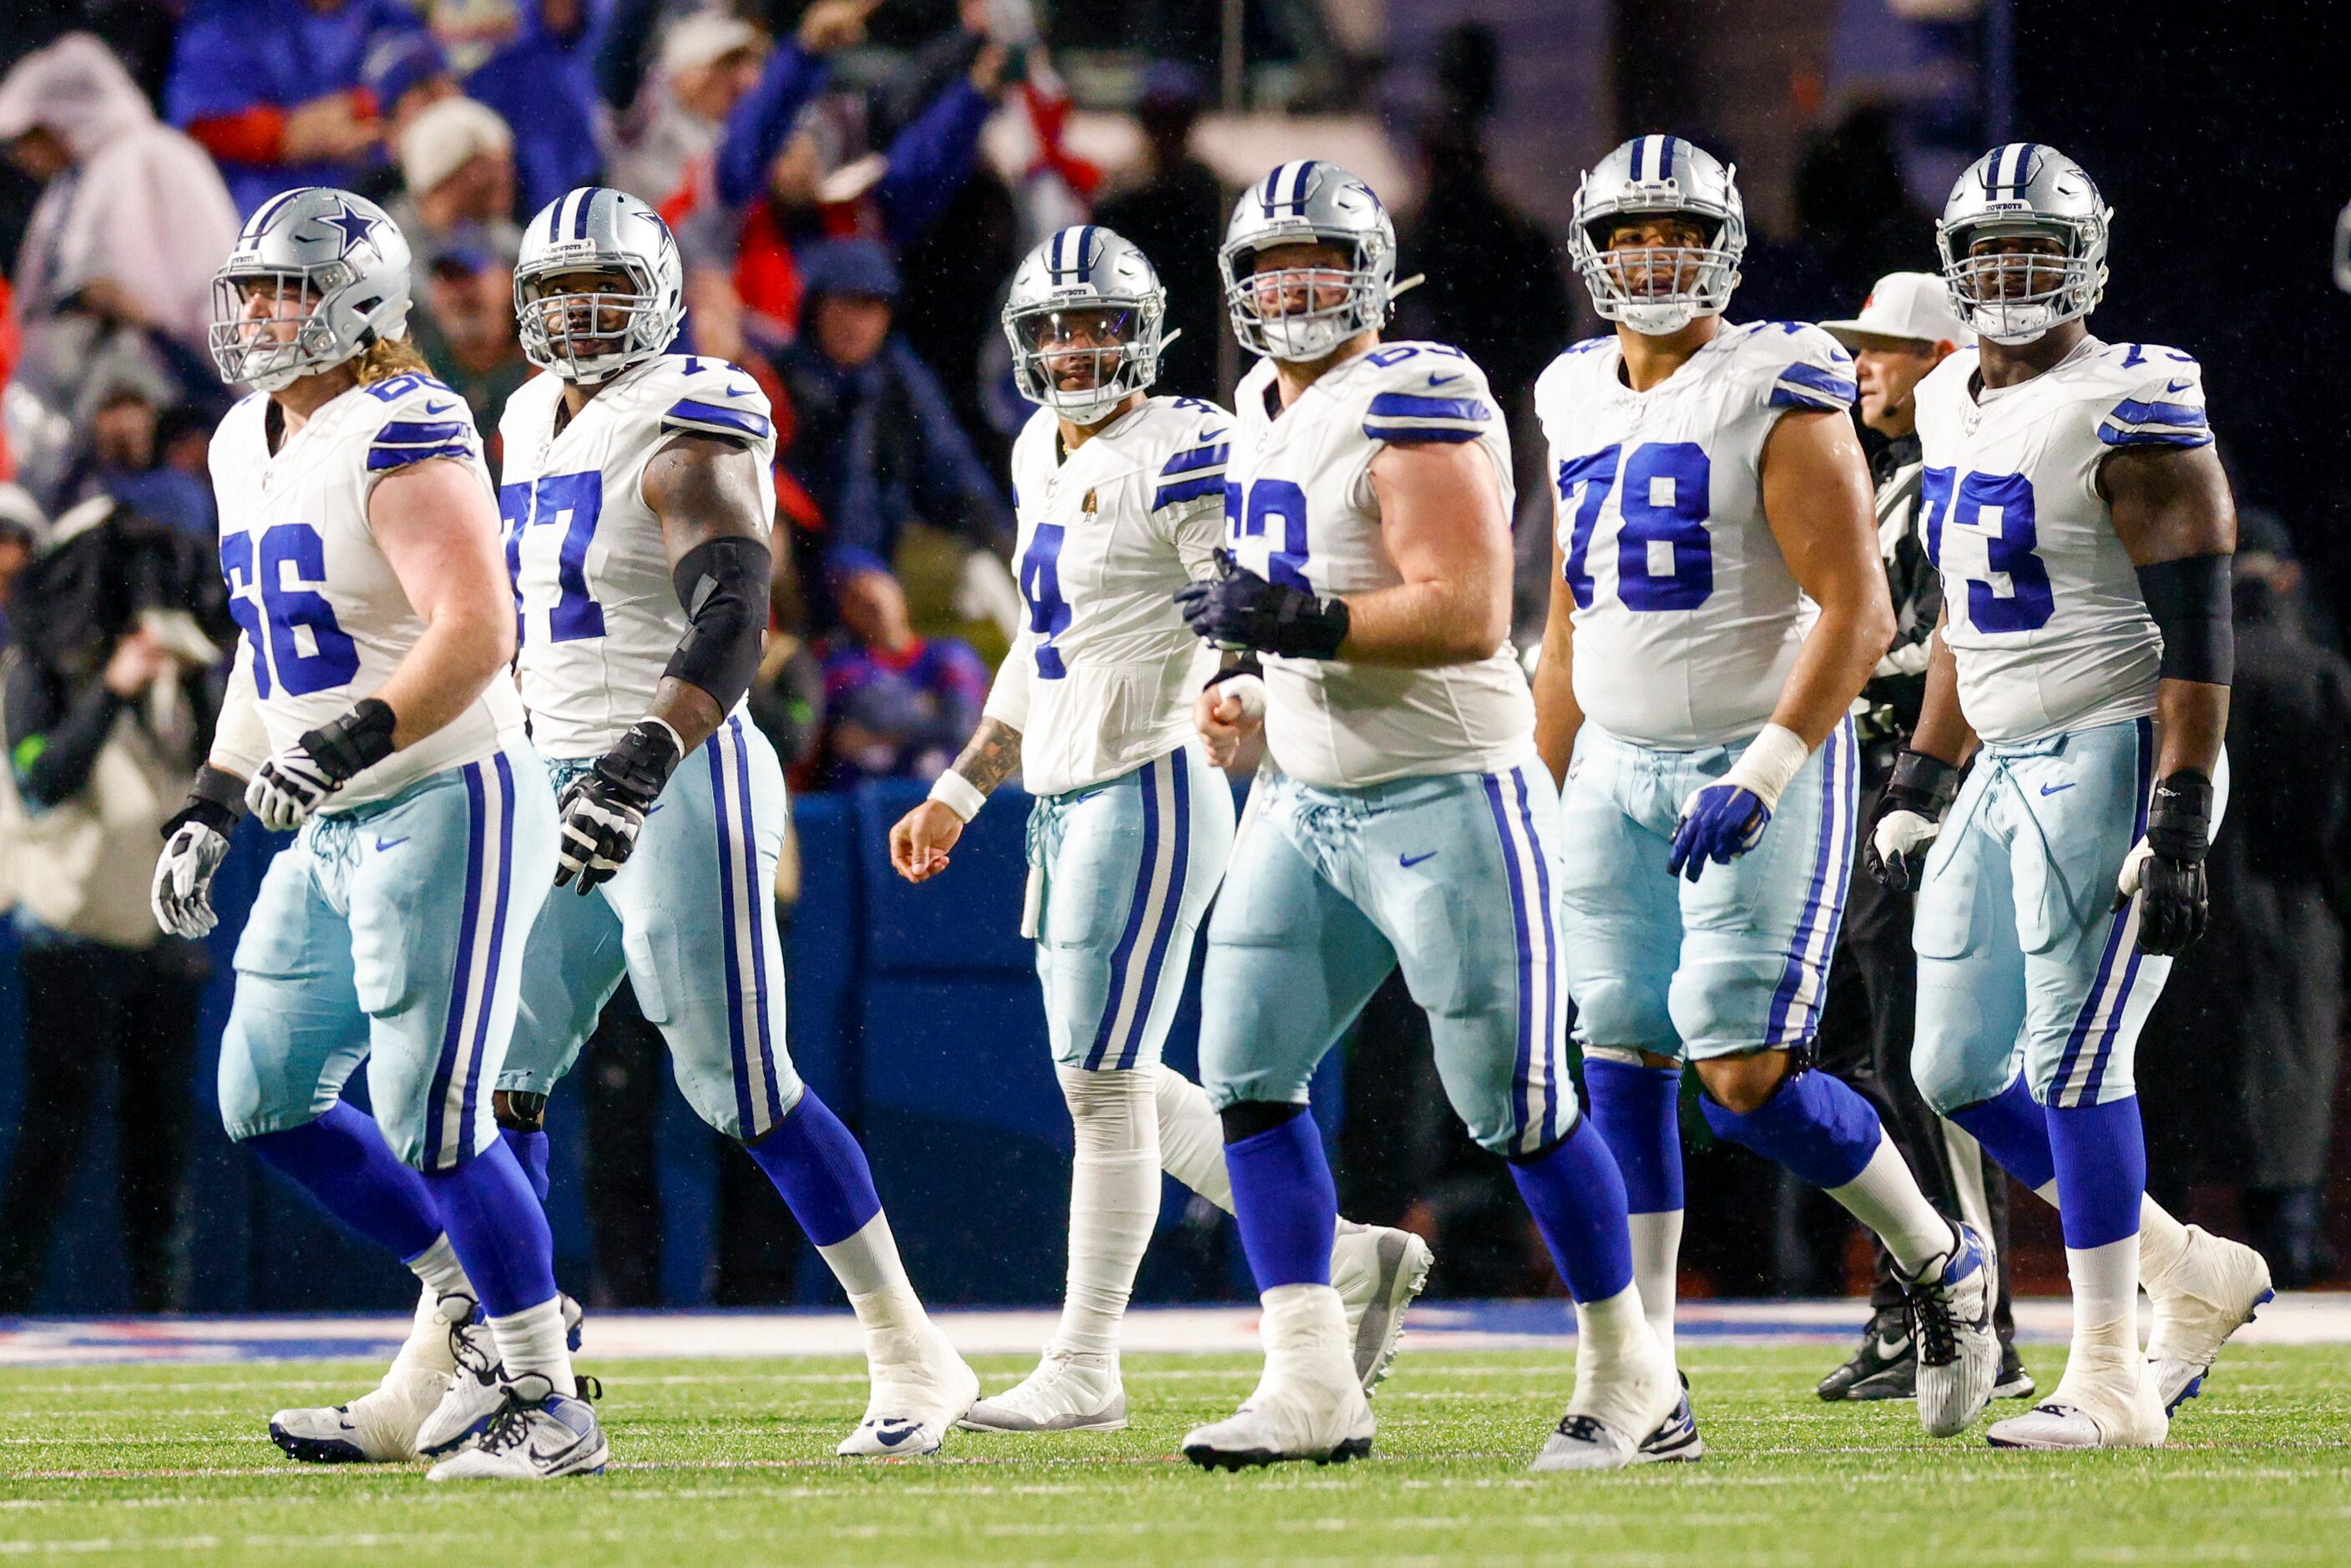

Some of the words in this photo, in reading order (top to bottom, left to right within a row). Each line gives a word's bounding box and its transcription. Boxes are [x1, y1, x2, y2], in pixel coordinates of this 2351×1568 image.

[551, 244, 582, 253] COWBOYS
[1985, 203, 2023, 211] COWBOYS
[220, 523, 361, 701] 66
[500, 470, 607, 649] 77
[1020, 522, 1073, 680] 4
[1557, 442, 1714, 612] 78
[1920, 465, 2055, 635] 73
